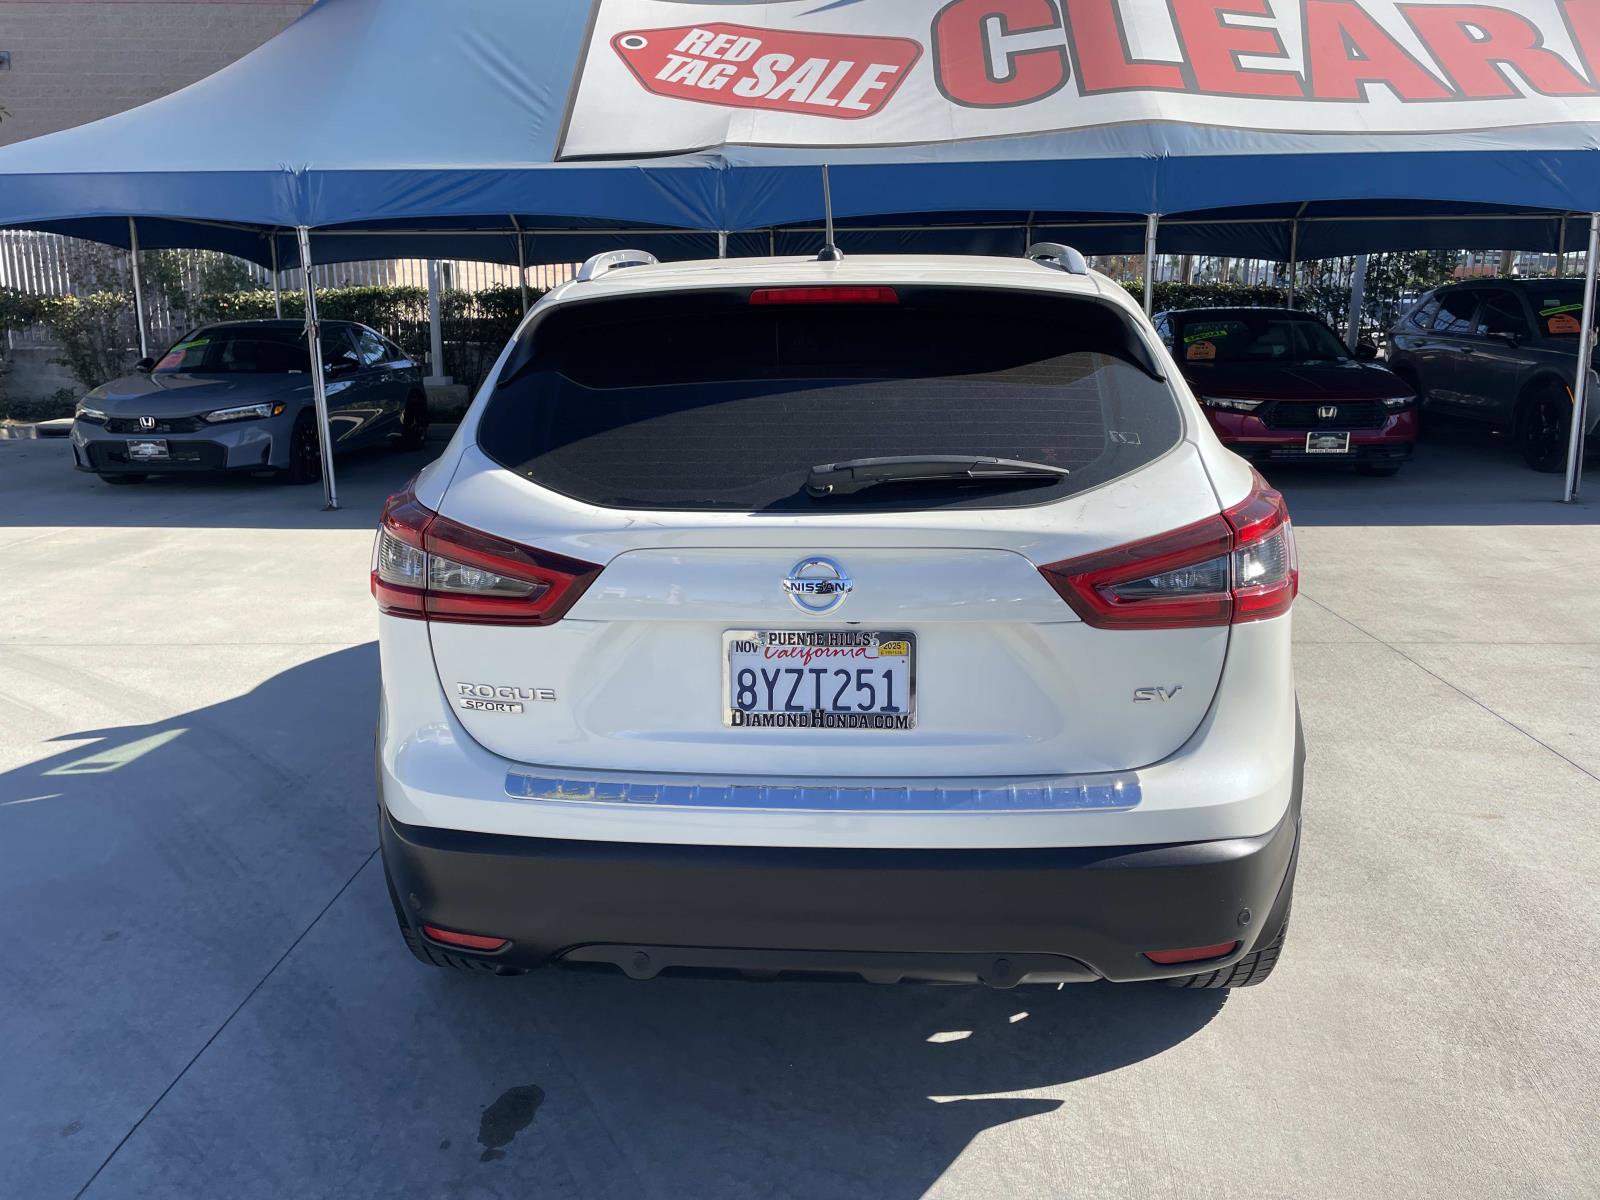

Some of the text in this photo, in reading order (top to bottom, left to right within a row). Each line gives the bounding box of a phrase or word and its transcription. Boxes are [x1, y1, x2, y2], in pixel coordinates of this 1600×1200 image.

[674, 27, 763, 63] RED
[930, 0, 1600, 110] CLEAR
[653, 52, 900, 111] TAG SALE
[790, 582, 845, 592] NISSAN
[735, 641, 758, 654] NOV
[768, 632, 871, 647] PUENTE HILLS
[883, 642, 902, 650] 2025
[764, 646, 879, 667] California
[456, 682, 557, 702] ROGUE
[736, 668, 900, 712] 8YZT251
[1133, 685, 1184, 704] SV
[465, 700, 516, 712] SPORT
